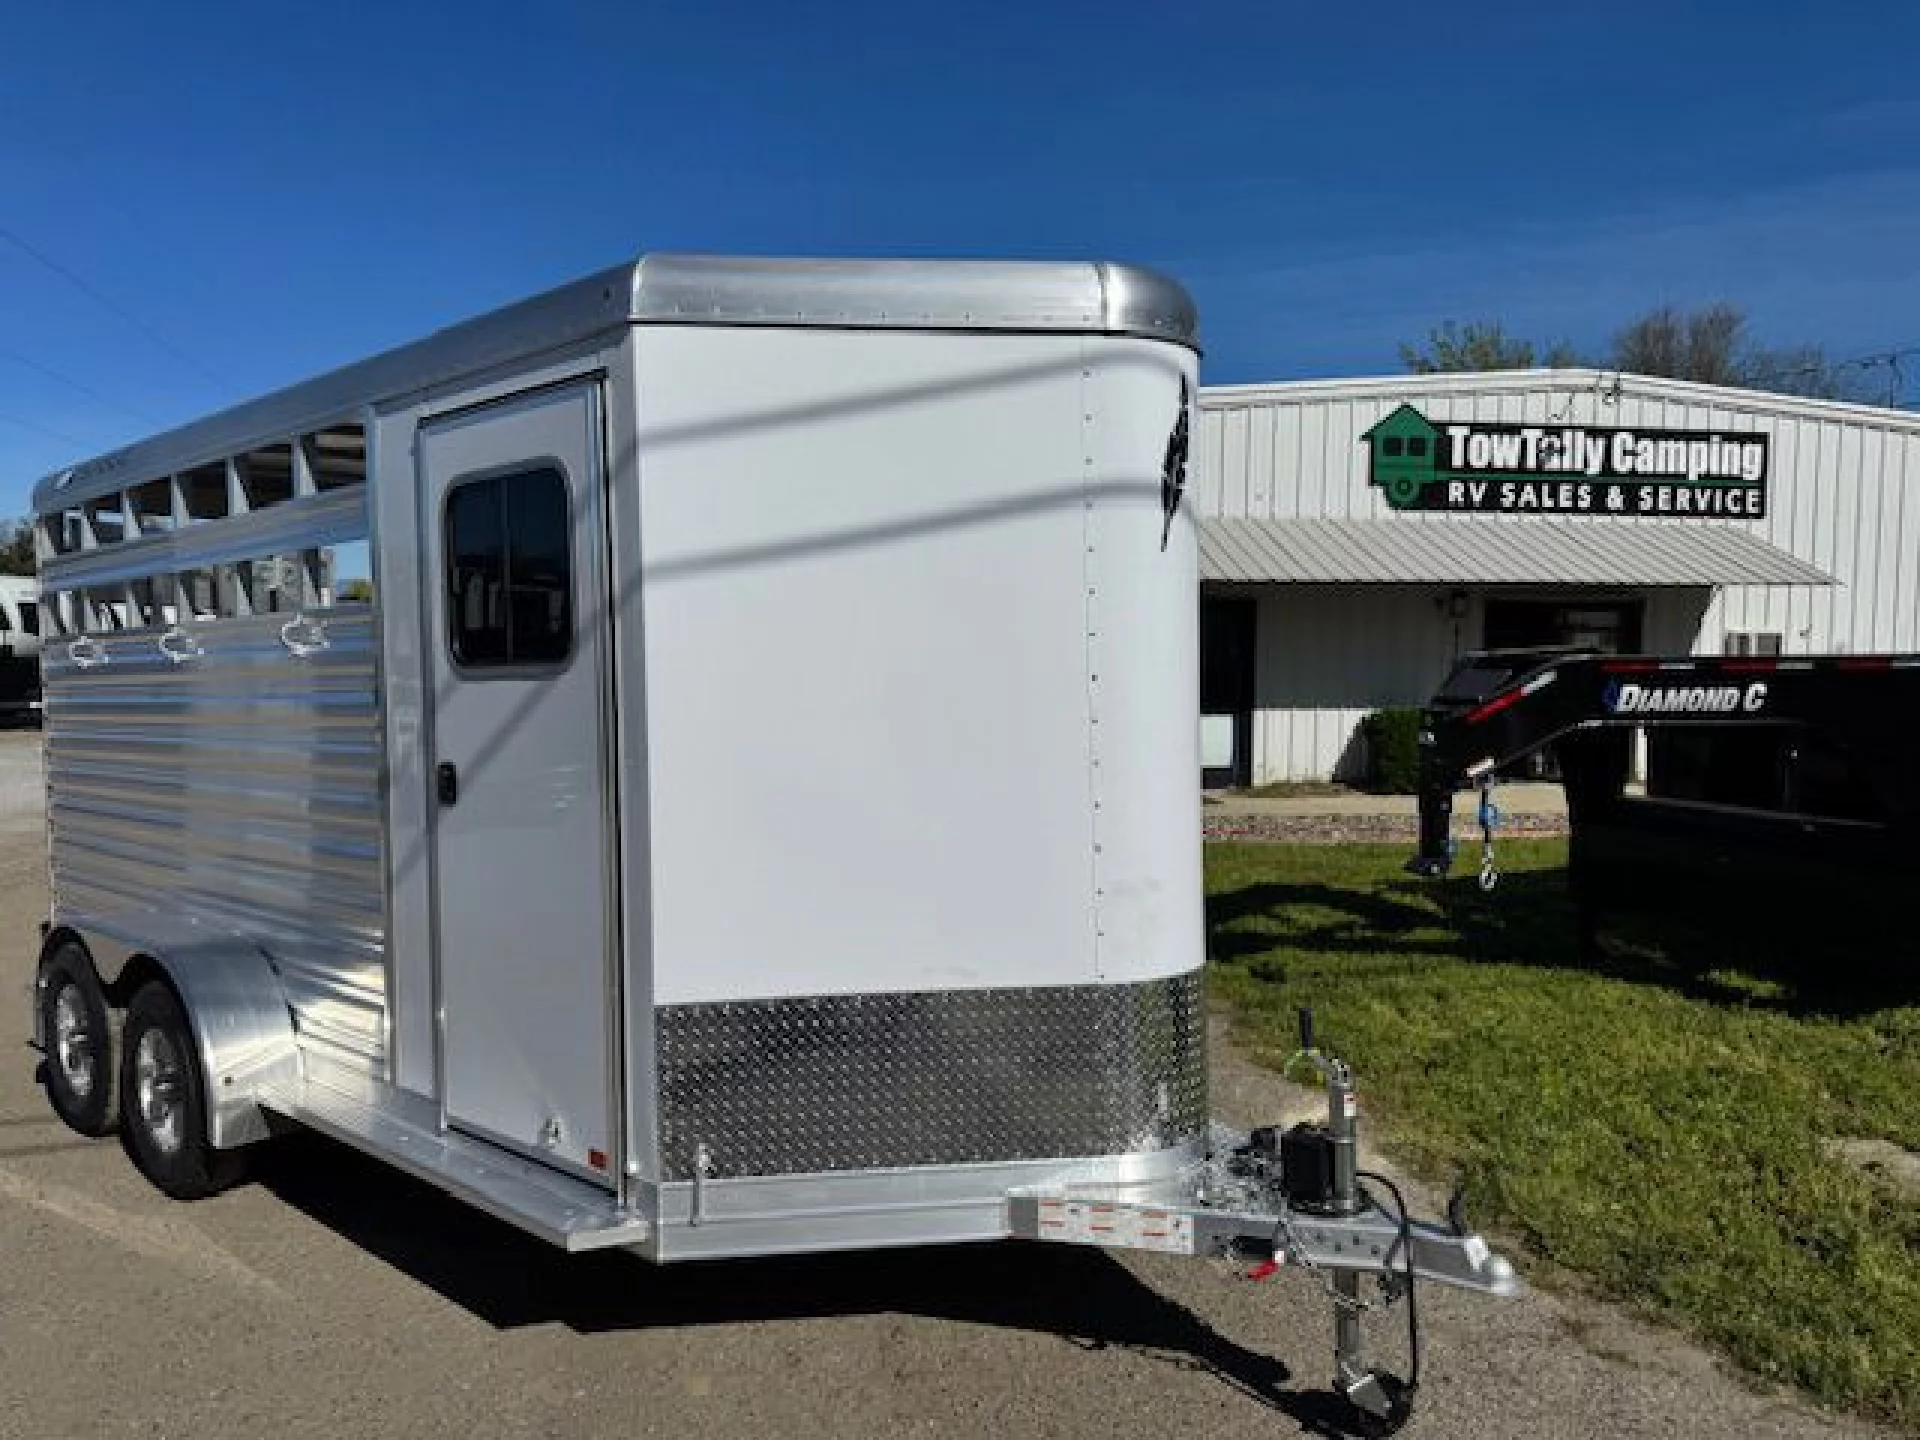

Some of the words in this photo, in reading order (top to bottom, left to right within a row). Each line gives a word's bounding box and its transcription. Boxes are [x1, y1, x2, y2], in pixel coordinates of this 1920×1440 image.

[1614, 431, 1764, 482] Camping
[1447, 481, 1488, 505] RV
[1501, 482, 1592, 510] SALES
[1605, 486, 1626, 511] &
[1639, 486, 1762, 516] SERVICE
[1743, 682, 1768, 712] C
